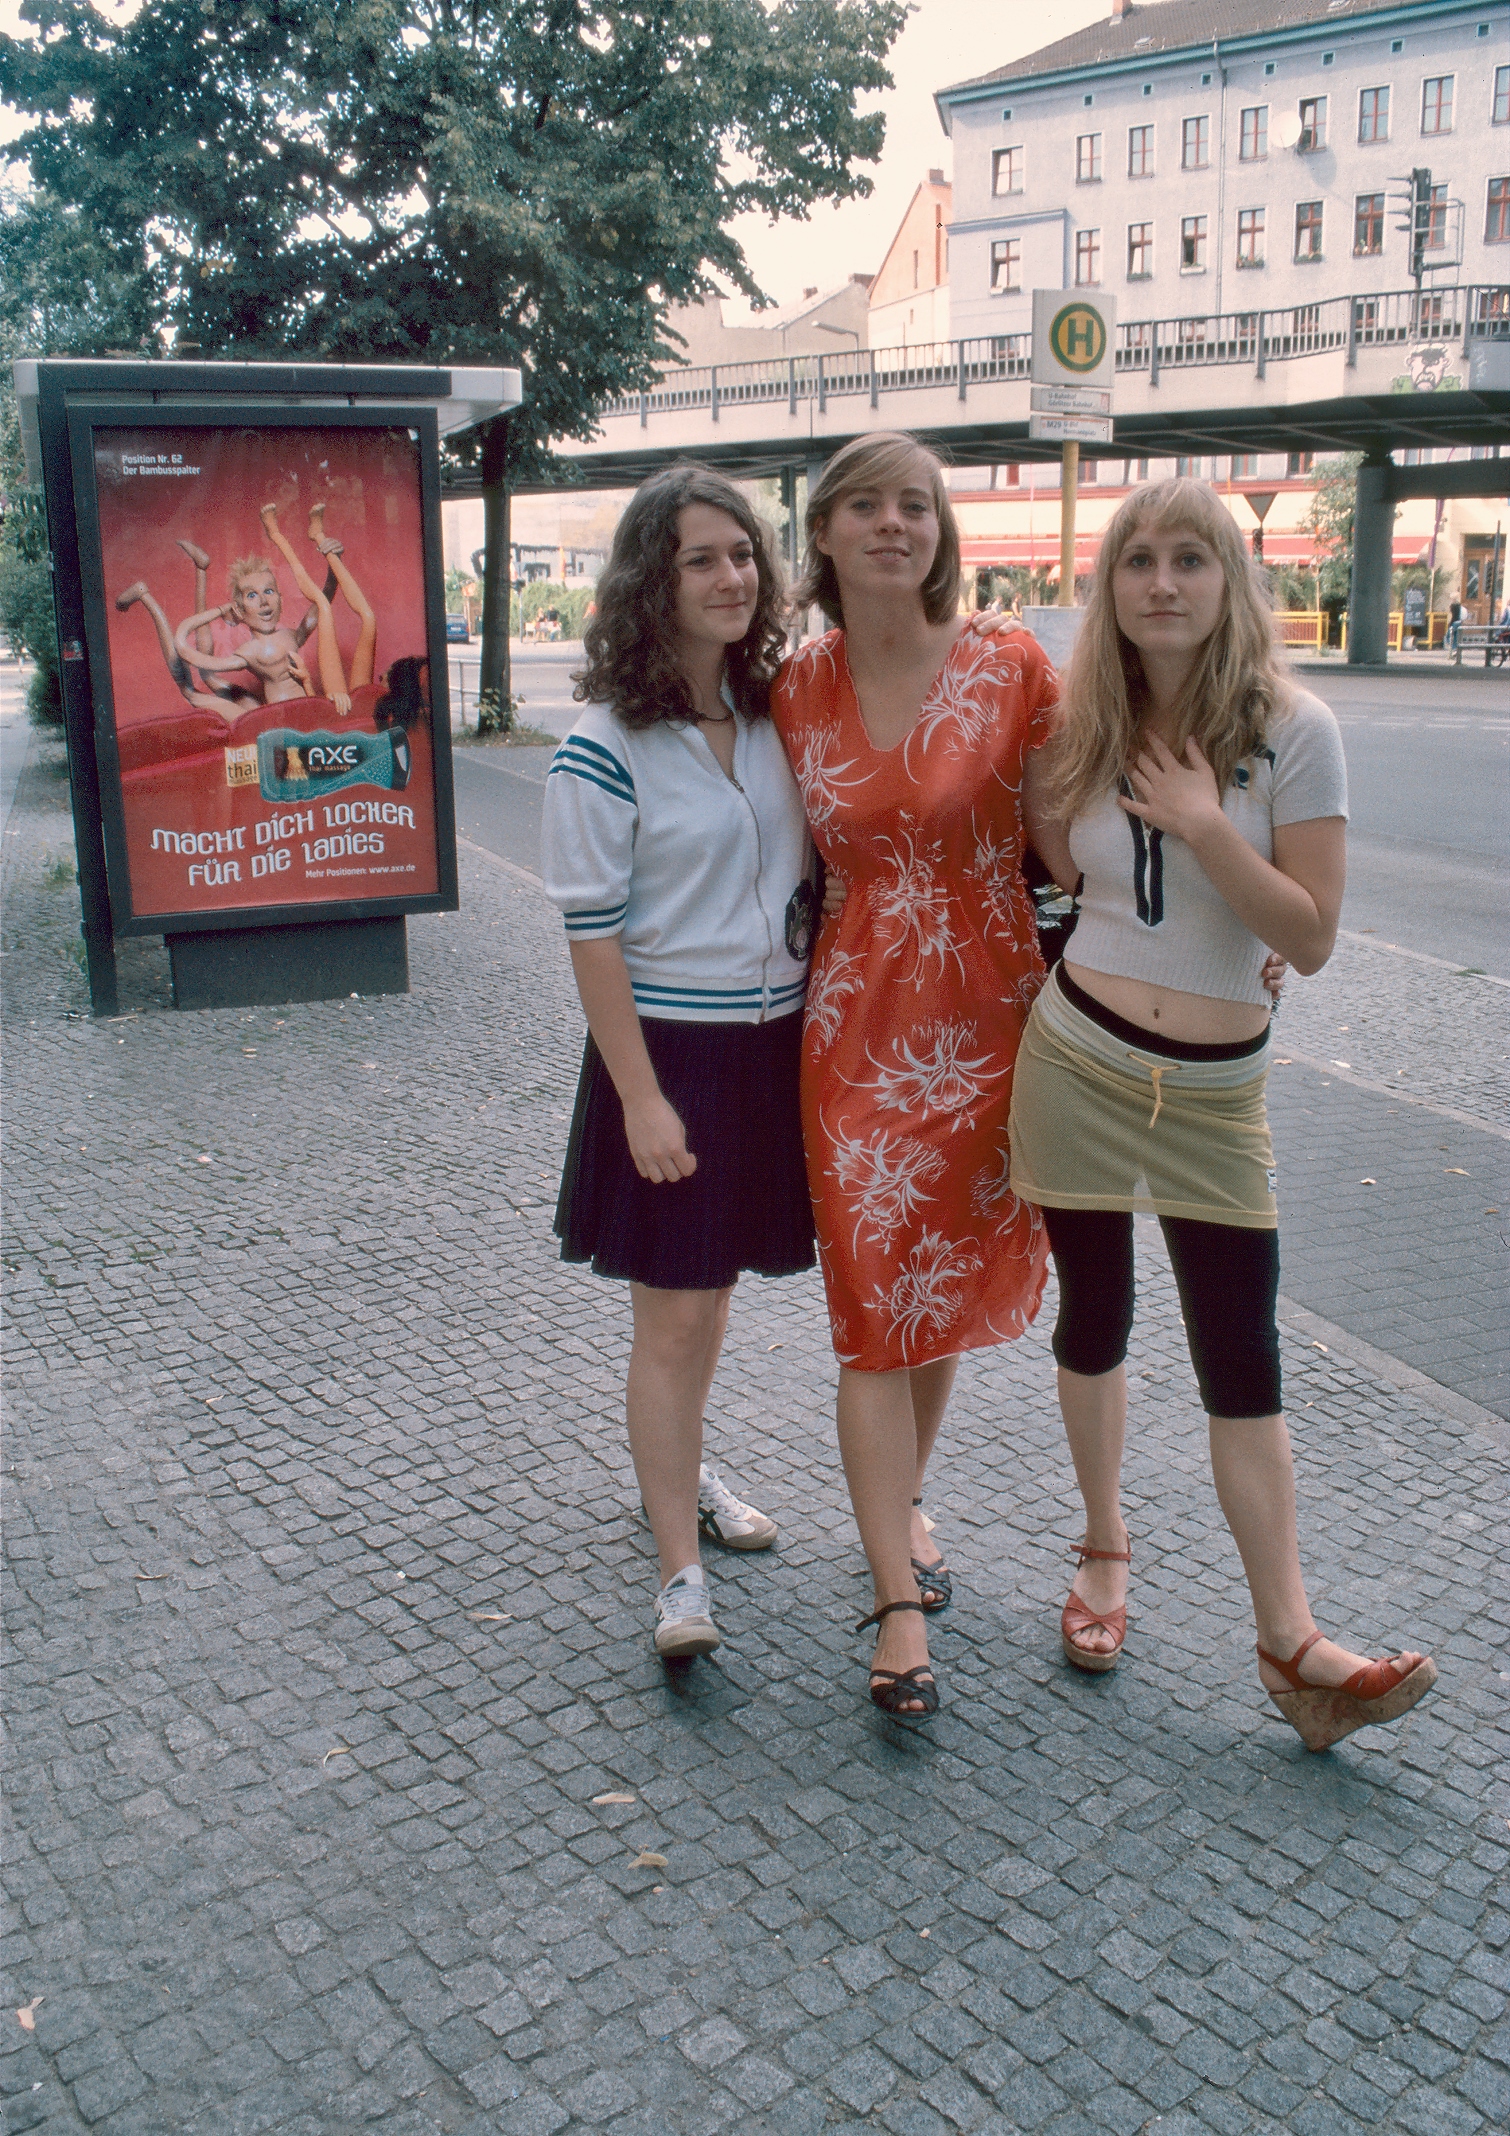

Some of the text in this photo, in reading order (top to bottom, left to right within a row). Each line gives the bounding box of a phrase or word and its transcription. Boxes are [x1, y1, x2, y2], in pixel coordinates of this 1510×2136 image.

[1067, 318, 1094, 356] H
[121, 453, 183, 464] Position Nr. 62
[123, 464, 201, 476] Der Bambusspalter
[308, 745, 358, 765] AXE
[227, 760, 257, 779] thai
[305, 863, 416, 878] Mehr Positionen: www.axe.de
